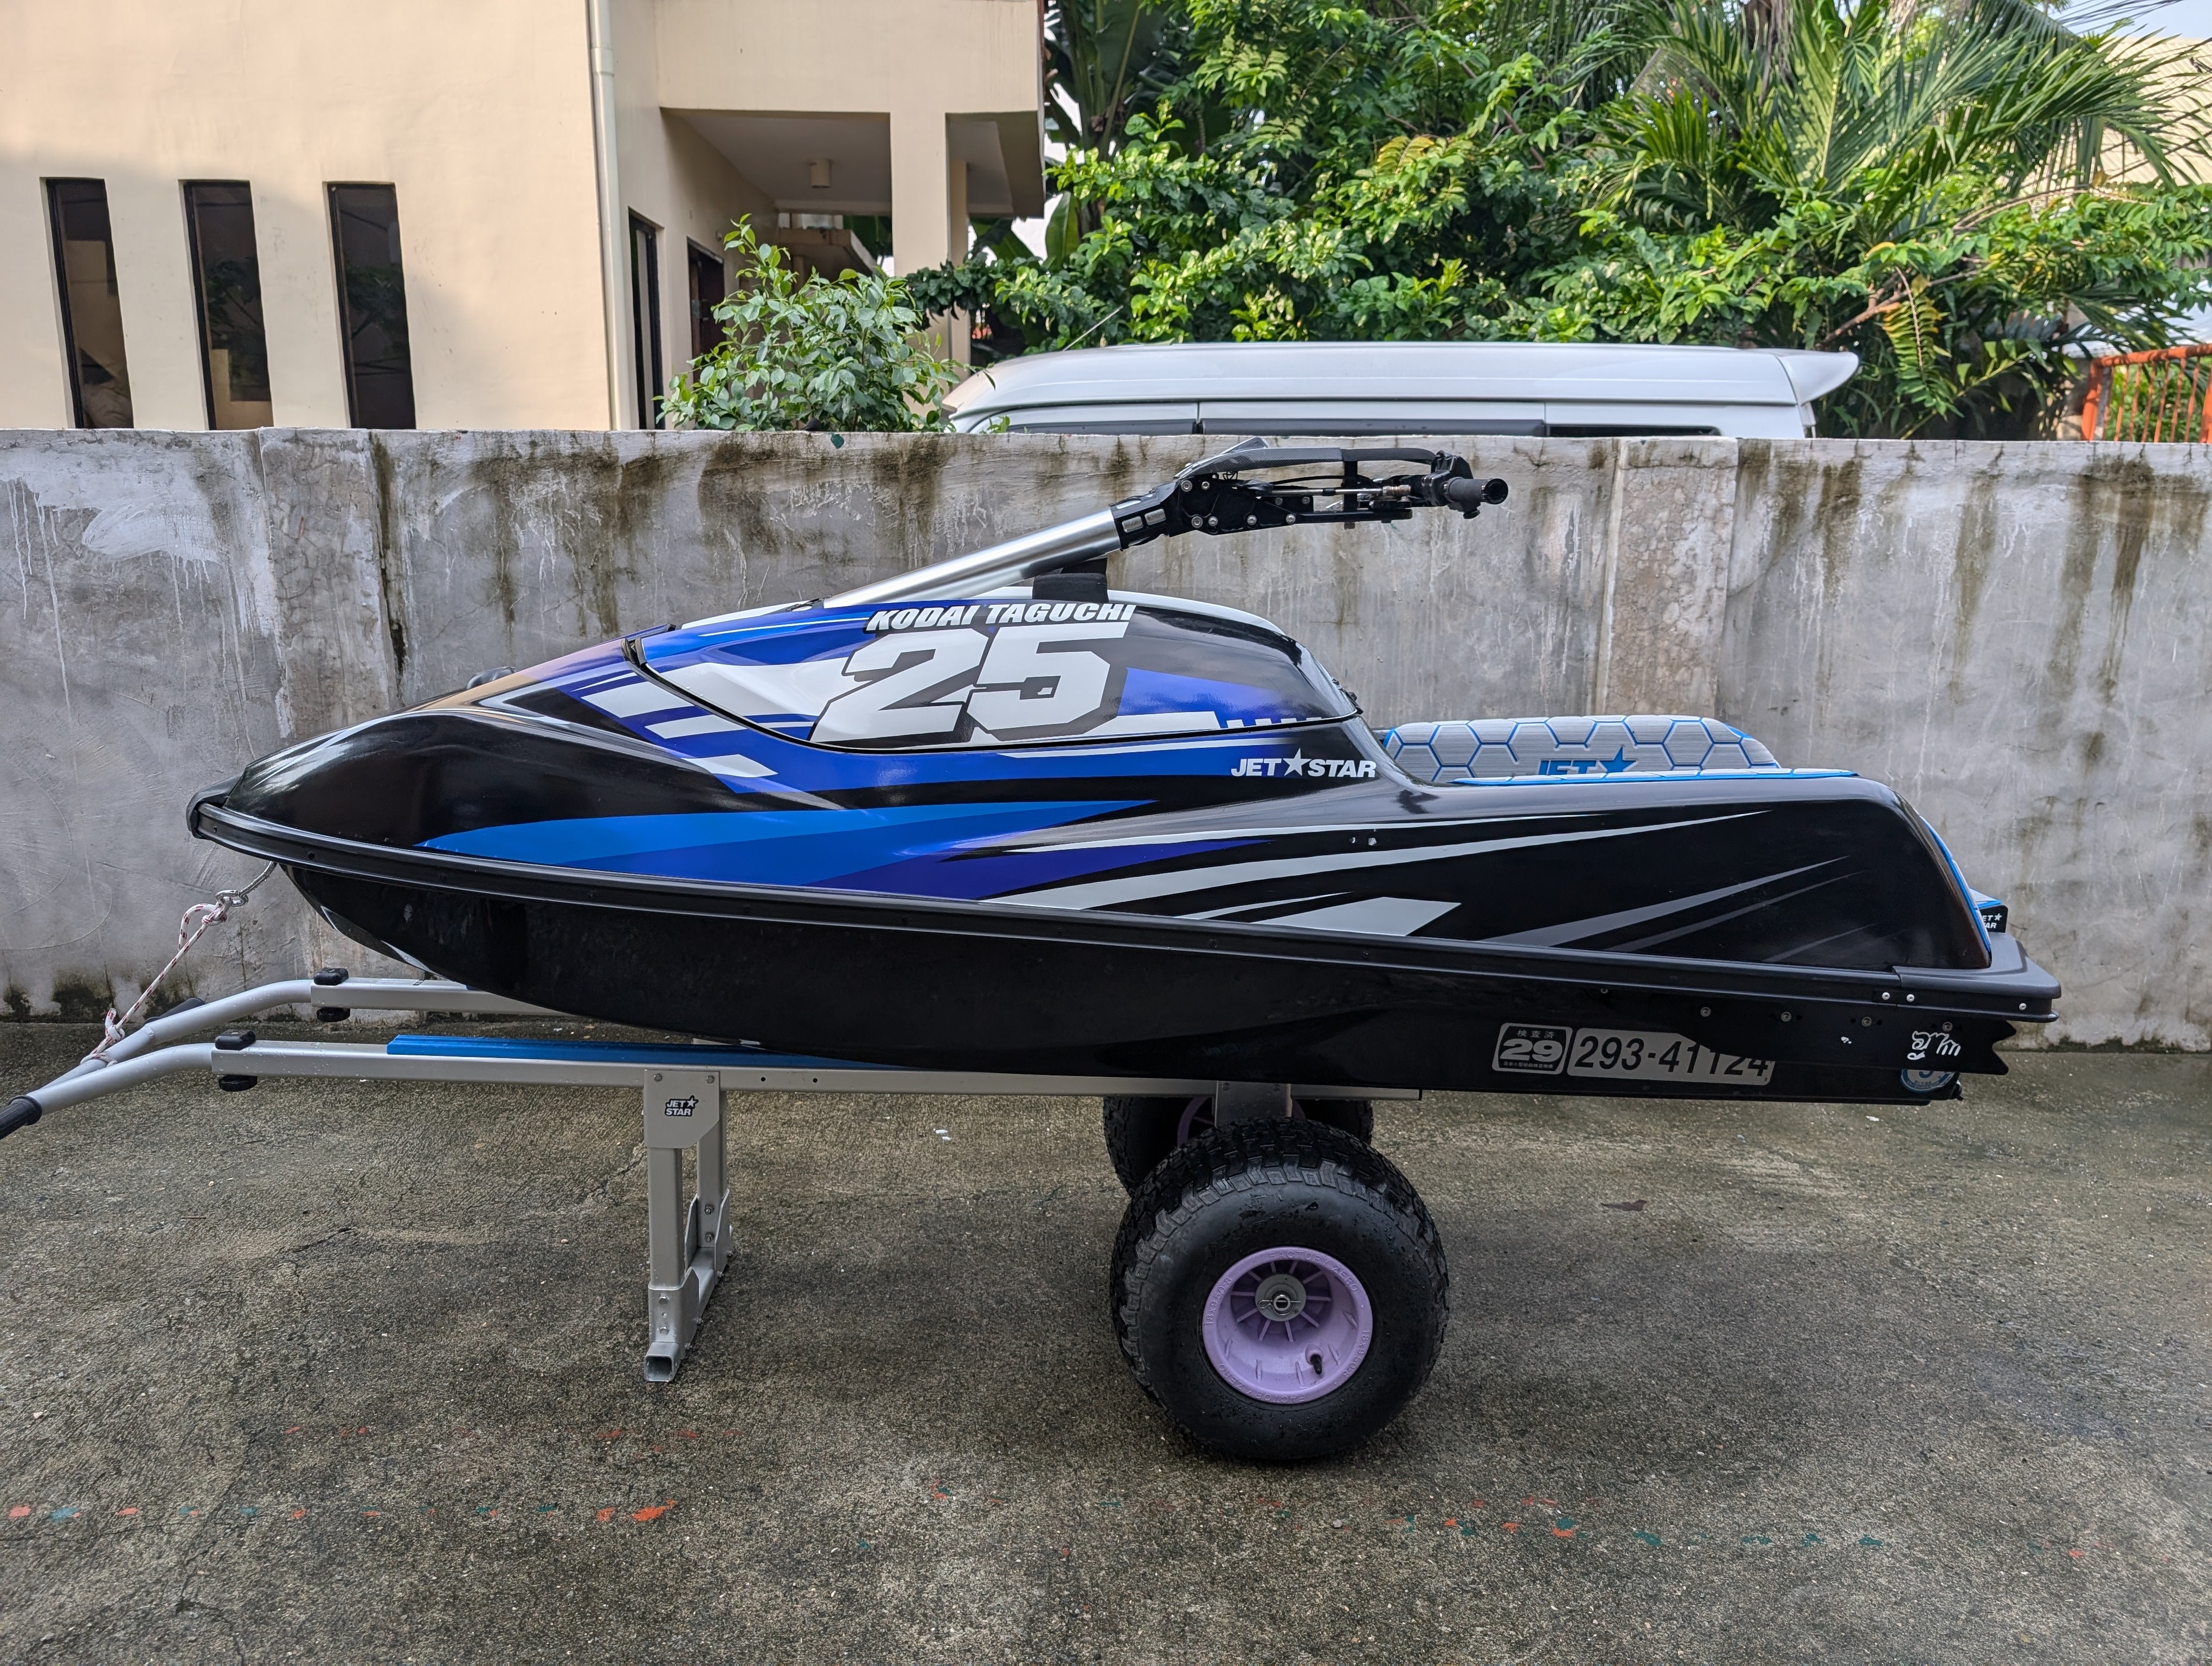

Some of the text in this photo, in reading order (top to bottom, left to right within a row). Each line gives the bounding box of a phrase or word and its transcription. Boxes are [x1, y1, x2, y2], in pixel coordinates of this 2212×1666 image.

[866, 603, 1136, 632] KODAI TAGUCHI
[809, 622, 1129, 742] 25
[1231, 758, 1377, 778] JET STAR
[1516, 1029, 1555, 1039] 検査済
[1500, 1038, 1562, 1062] 29
[1269, 1250, 1359, 1291] FACTORY ZERO
[1219, 1363, 1245, 1389] ZERO
